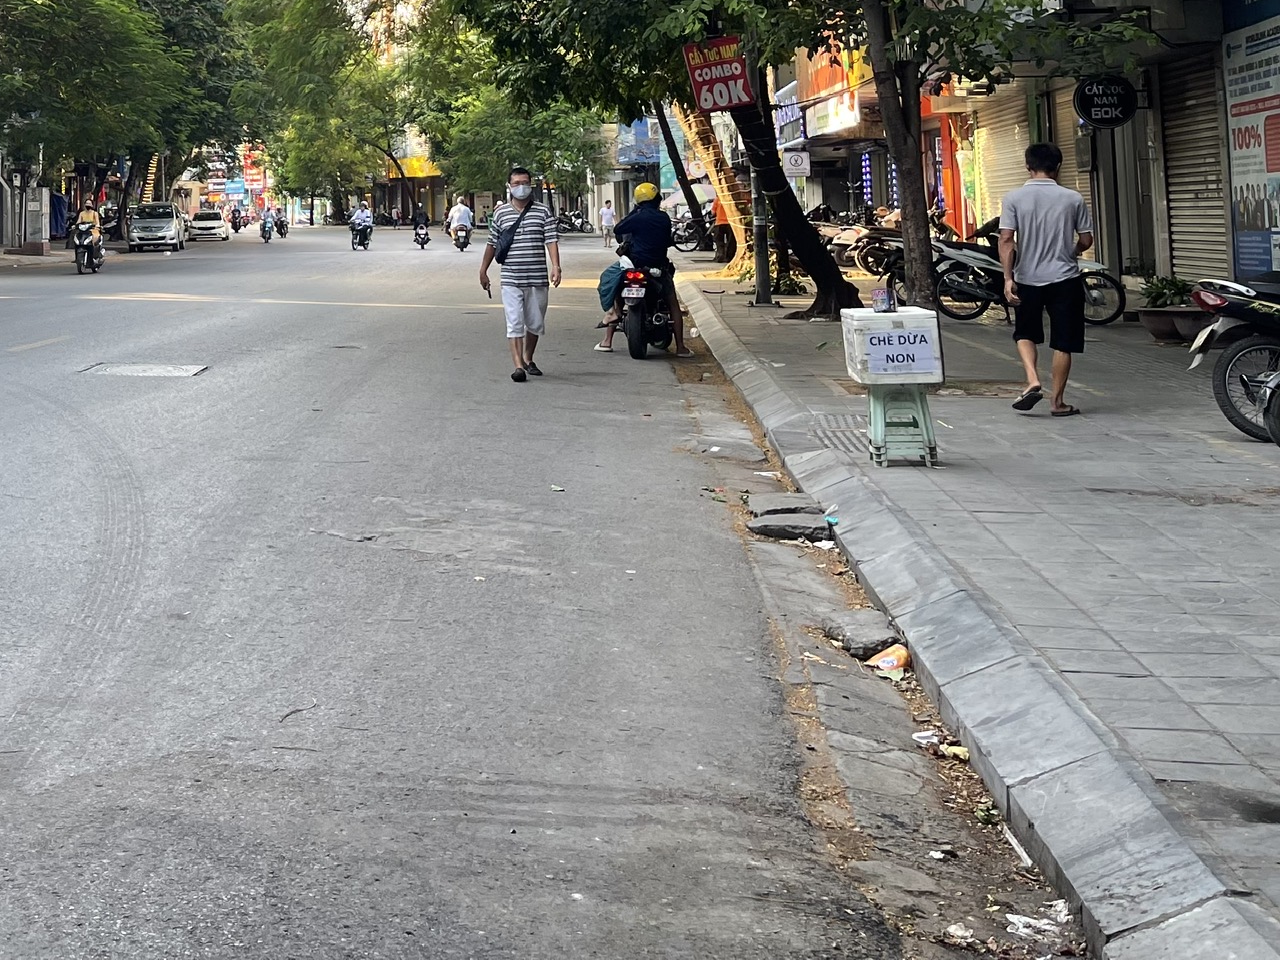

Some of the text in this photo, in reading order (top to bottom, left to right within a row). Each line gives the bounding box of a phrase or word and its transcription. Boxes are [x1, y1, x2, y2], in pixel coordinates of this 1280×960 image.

[694, 62, 742, 82] COMBO
[700, 78, 751, 110] 60K
[1093, 96, 1118, 105] NAM
[1091, 106, 1124, 119] 60K
[1231, 123, 1262, 152] 100%
[869, 332, 928, 346] CHÈ DỪA
[885, 353, 915, 364] NON
